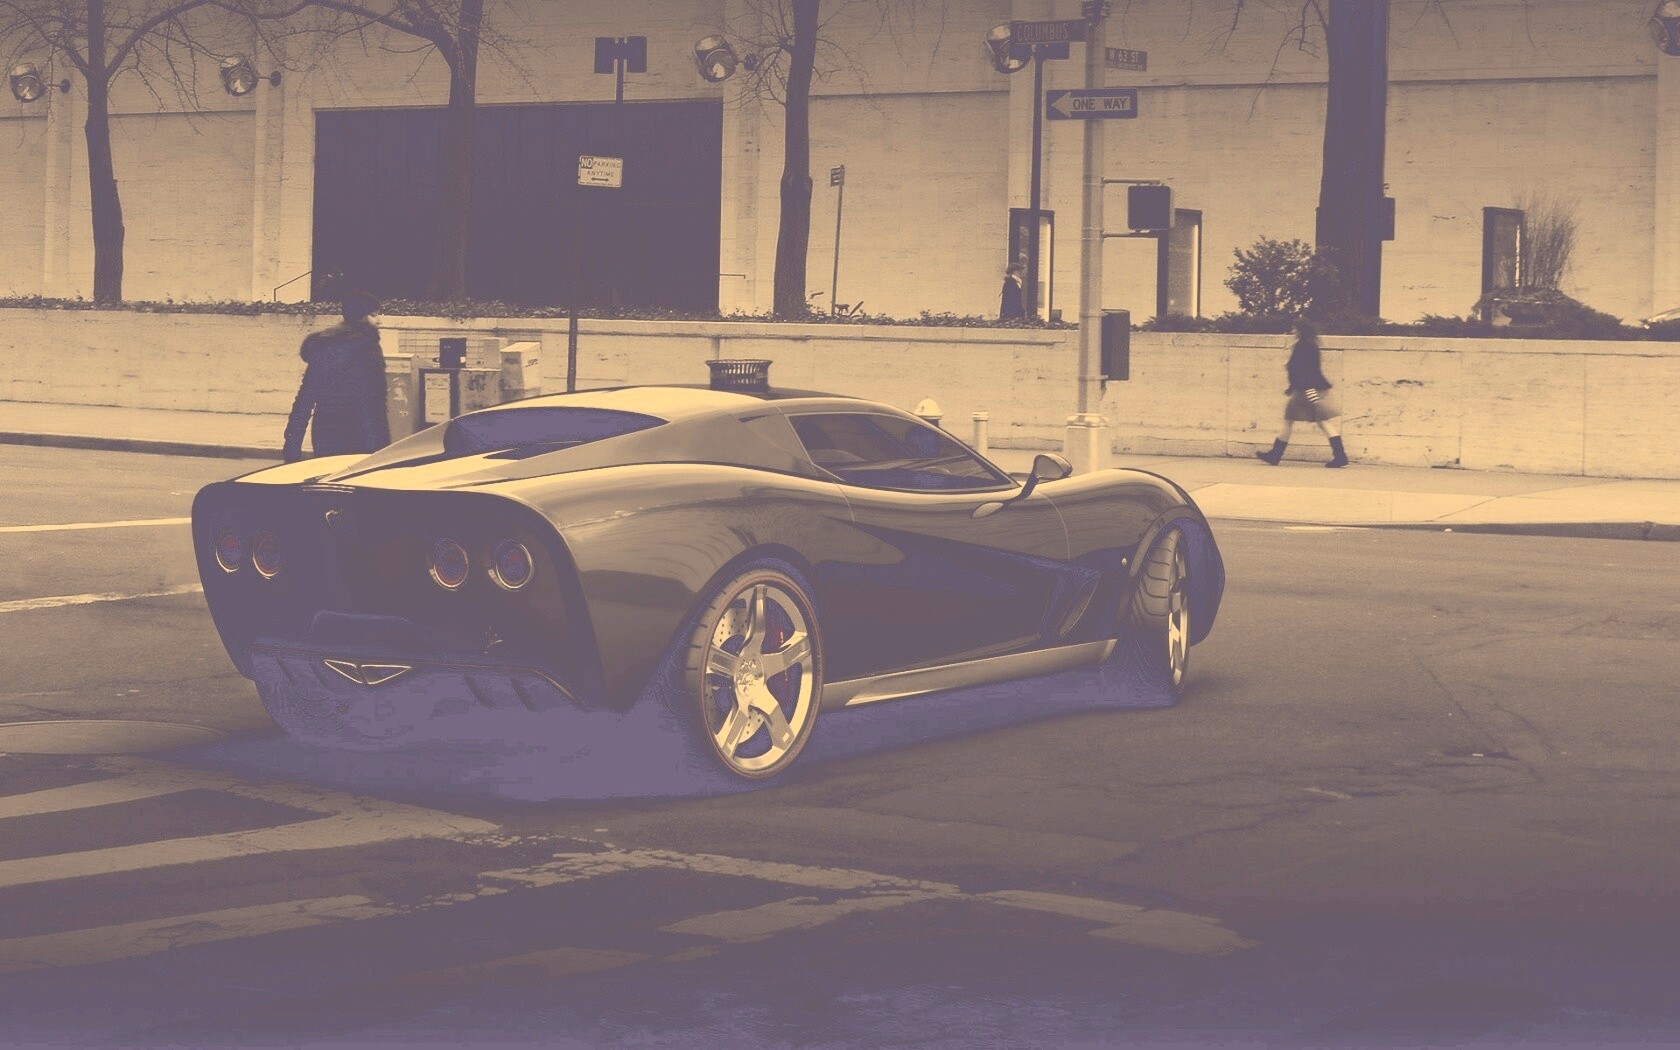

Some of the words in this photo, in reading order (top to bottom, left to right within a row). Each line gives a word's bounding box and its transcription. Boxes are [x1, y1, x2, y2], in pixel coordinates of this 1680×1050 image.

[1017, 22, 1069, 42] COLUMBUS
[1118, 51, 1128, 62] 63
[1131, 52, 1139, 62] ST
[1072, 99, 1096, 110] ONE
[1103, 97, 1128, 110] WAY
[581, 157, 592, 168] NO
[593, 160, 620, 168] PARKING
[586, 170, 615, 178] ANYTIME
